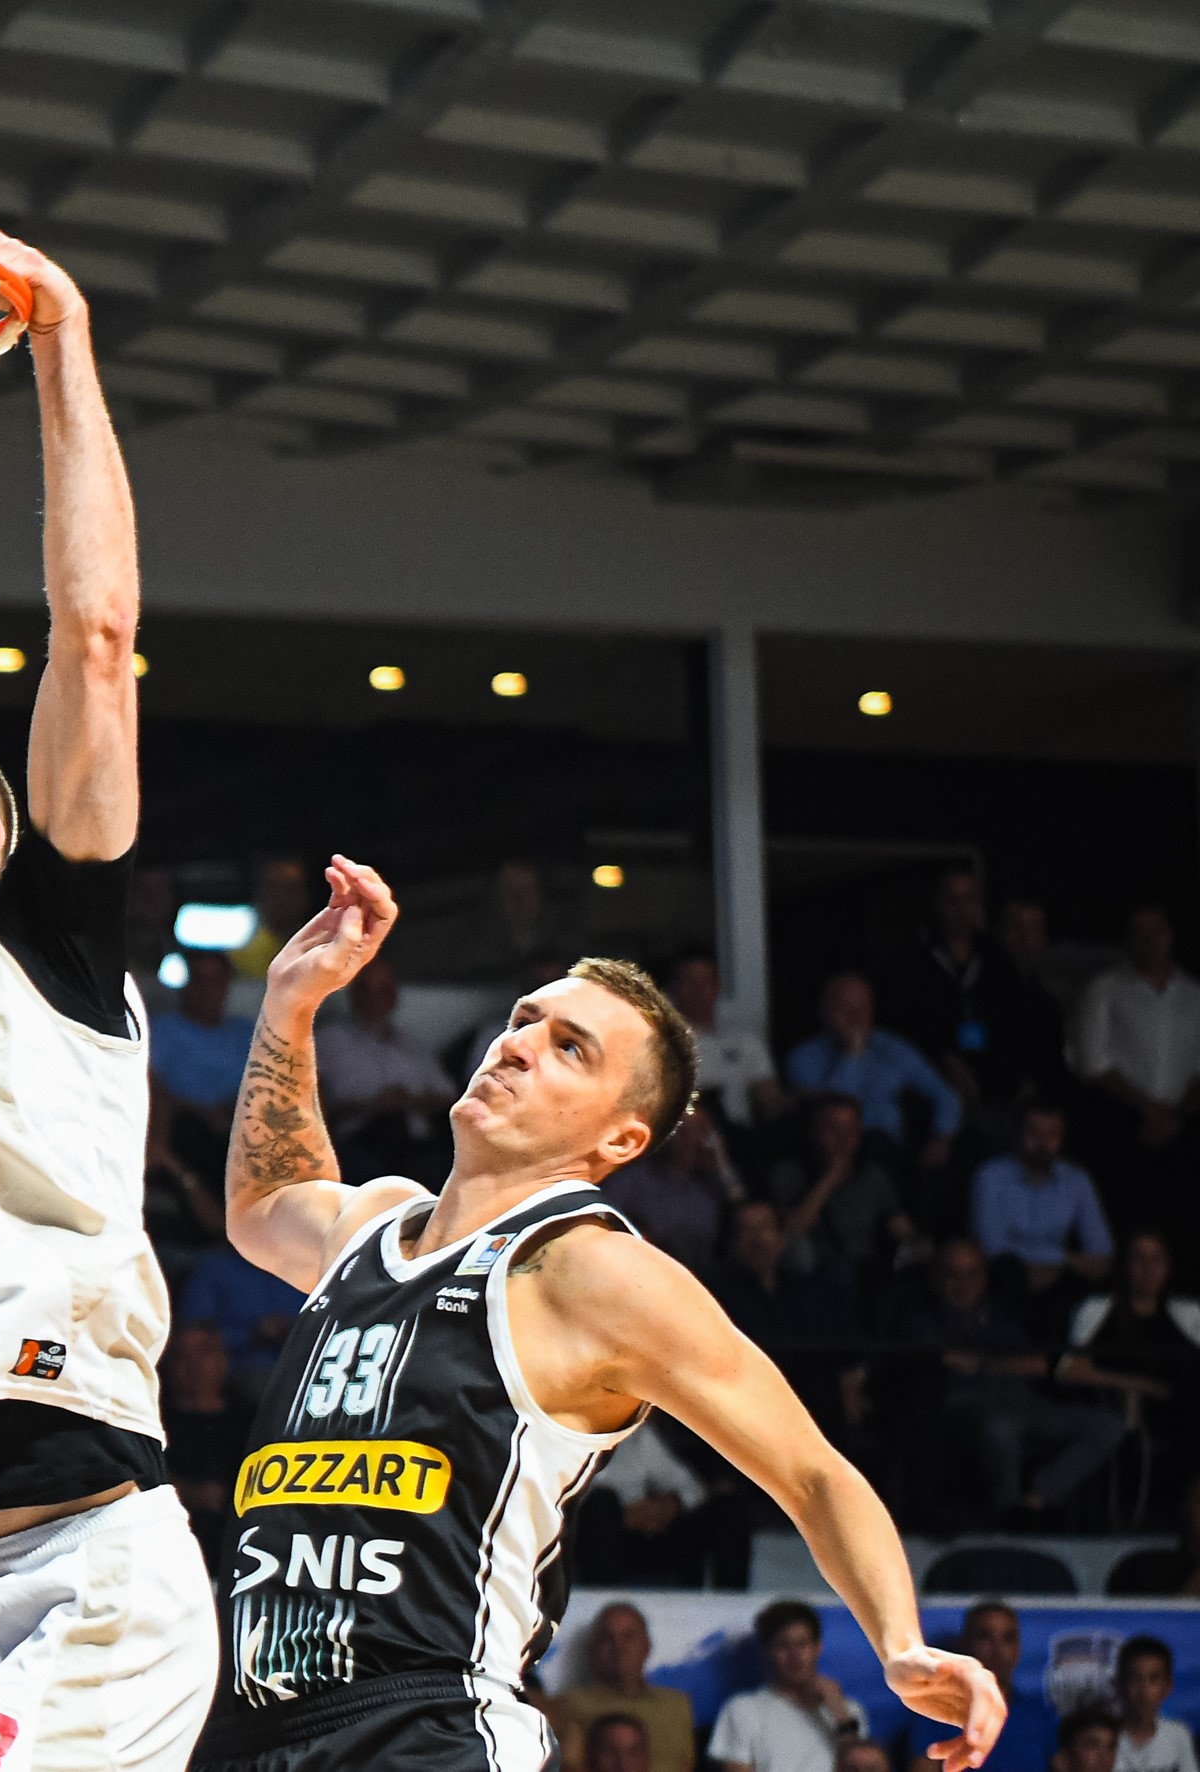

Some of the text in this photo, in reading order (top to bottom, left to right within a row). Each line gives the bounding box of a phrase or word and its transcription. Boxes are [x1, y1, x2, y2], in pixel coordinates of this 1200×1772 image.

[436, 1297, 468, 1314] Bank
[305, 1323, 398, 1418] 33
[285, 1533, 405, 1595] NIS
